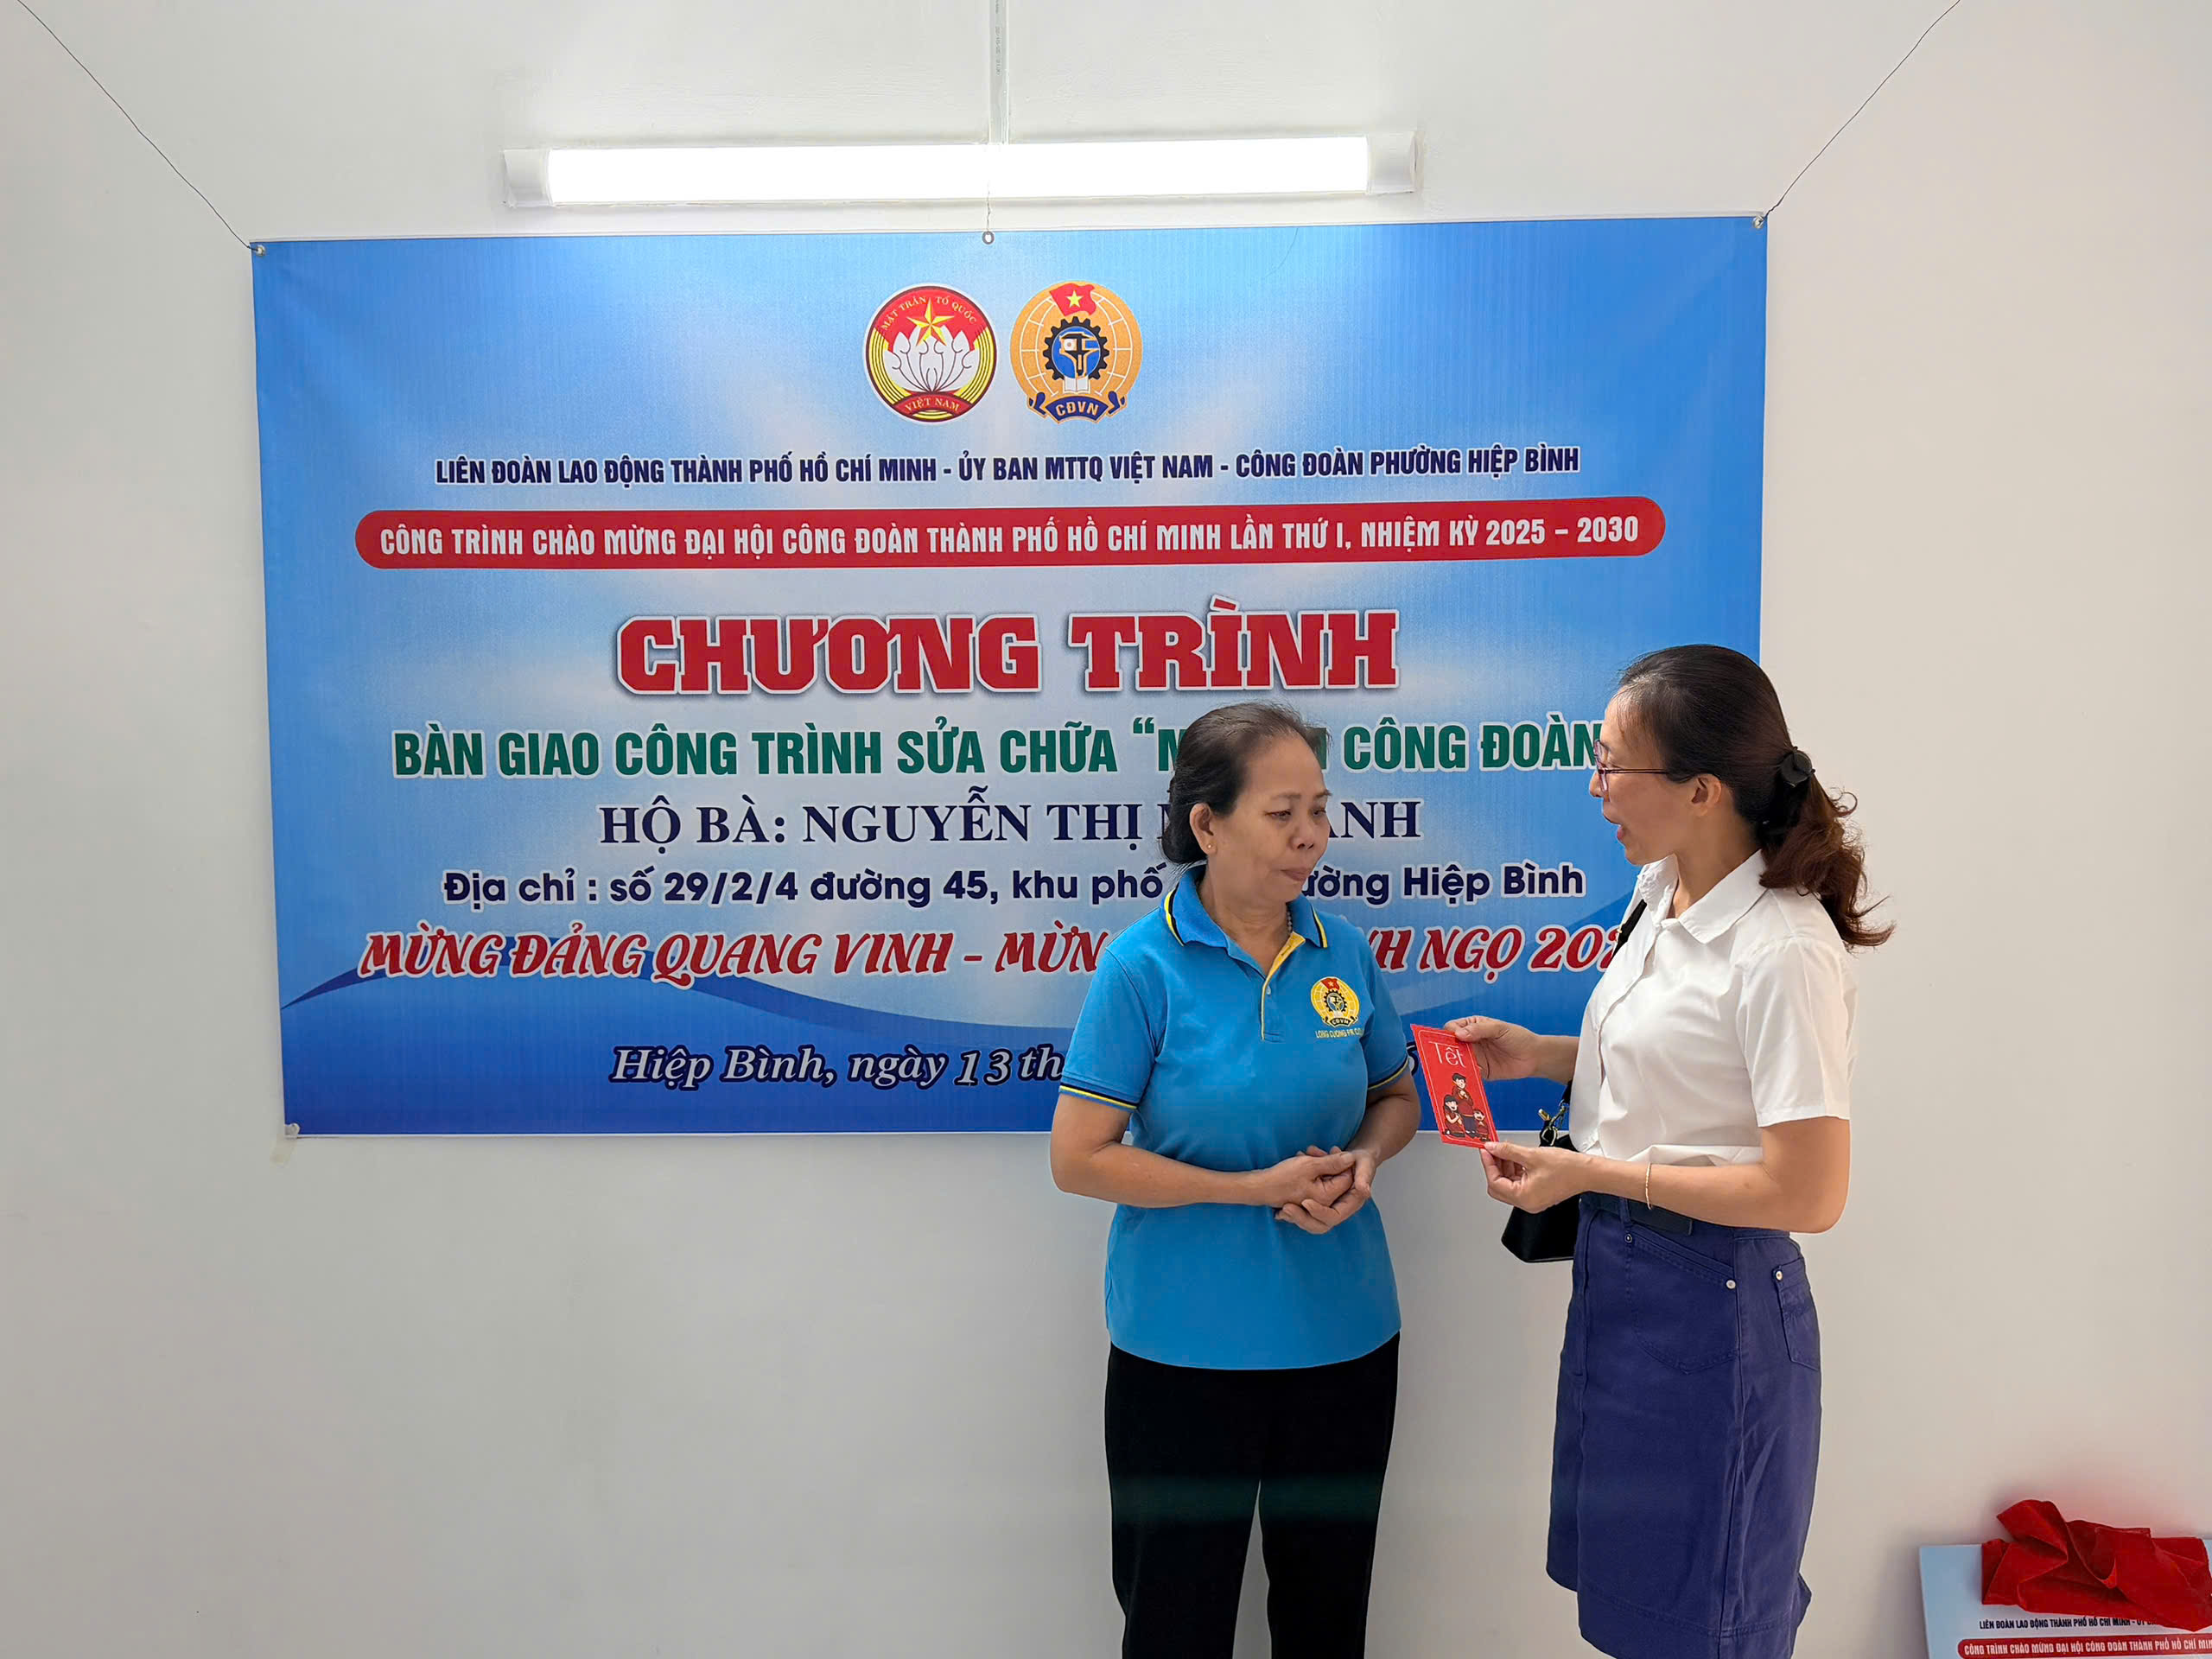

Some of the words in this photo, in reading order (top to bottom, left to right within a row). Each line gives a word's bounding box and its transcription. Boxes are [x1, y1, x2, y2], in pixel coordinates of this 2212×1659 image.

[934, 397, 961, 412] NAM
[1056, 401, 1100, 417] CĐVN
[436, 456, 485, 483] LIÊN
[492, 455, 551, 483] ĐOÀN
[558, 460, 598, 483] LAO
[604, 455, 664, 488] ĐỘNG
[671, 454, 741, 482] THÀNH
[749, 451, 793, 482] PHỐ
[799, 451, 828, 482] HỒ
[836, 454, 871, 481] CHÍ
[879, 458, 937, 481] MINH
[958, 450, 986, 480] ỦY
[994, 457, 1037, 480] BAN
[1046, 455, 1103, 481] MTTQ
[1110, 451, 1155, 484] VIỆT
[1162, 454, 1213, 478] NAM
[1236, 449, 1295, 477] CÔNG
[1302, 447, 1363, 476] ĐOÀN
[1371, 445, 1460, 474] PHƯỜNG
[1469, 445, 1518, 478] HIỆP
[1525, 443, 1579, 472] BÌNH
[380, 523, 442, 555] CÔNG
[451, 524, 523, 555] TRÌNH
[532, 524, 595, 555] CHÀO
[604, 524, 677, 556] MỪNG
[684, 529, 725, 560] ĐẠI
[734, 523, 773, 560] HỘI
[783, 523, 846, 555] CÔNG
[854, 522, 918, 554] ĐOÀN
[927, 522, 1003, 553] THÀNH
[1012, 516, 1058, 552] PHỐ
[1067, 515, 1098, 552] HỒ
[1108, 519, 1147, 552] CHÍ
[1156, 524, 1221, 550] MINH
[1230, 513, 1274, 550] LẦN
[1281, 517, 1329, 550] THỨ
[1336, 522, 1352, 550] I,
[1361, 515, 1440, 552] NHIỆM
[1449, 515, 1479, 546] KỲ
[1486, 518, 1546, 545] 2025
[1577, 515, 1639, 543] 2030
[619, 614, 1040, 694] CHƯƠNG
[1070, 597, 1398, 690] TRÌNH
[394, 722, 483, 775] BÀN
[499, 732, 599, 776] GIAO
[615, 723, 737, 775] CÔNG
[752, 722, 881, 774] TRÌNH
[897, 716, 985, 773] SỬA
[1000, 721, 1118, 772] CHỮA
[1344, 717, 1466, 769] CÔNG
[599, 795, 682, 855] HỘ
[696, 795, 785, 842] BÀ:
[803, 785, 1032, 843] NGUYỄN
[1046, 804, 1142, 850] THỊ
[443, 871, 505, 910] Địa
[518, 868, 575, 901] chỉ
[610, 865, 655, 902] số
[664, 871, 798, 906] 29/2/4
[810, 868, 931, 908] đường
[943, 870, 999, 905] 45,
[1014, 870, 1077, 899] khu
[1092, 862, 1167, 905] phố
[1403, 864, 1491, 904] Hiệp
[1503, 861, 1583, 895] Bình
[359, 922, 506, 977] MỪNG
[511, 922, 648, 977] ĐẢNG
[653, 932, 823, 988] QUANG
[834, 931, 954, 975] VINH
[995, 919, 1109, 974] MỪN
[1420, 927, 1523, 982] NGỌ
[611, 1046, 712, 1089] Hiệp
[724, 1046, 836, 1087] Bình,
[849, 1046, 947, 1087] ngày
[2016, 1619, 2029, 1629] LAO
[1964, 1643, 1985, 1656] CÔNG
[1986, 1643, 2008, 1655] TRÌNH
[2010, 1642, 2030, 1654] CHÀO
[2085, 1641, 2106, 1653] CÔNG
[2129, 1639, 2153, 1651] THÀNH
